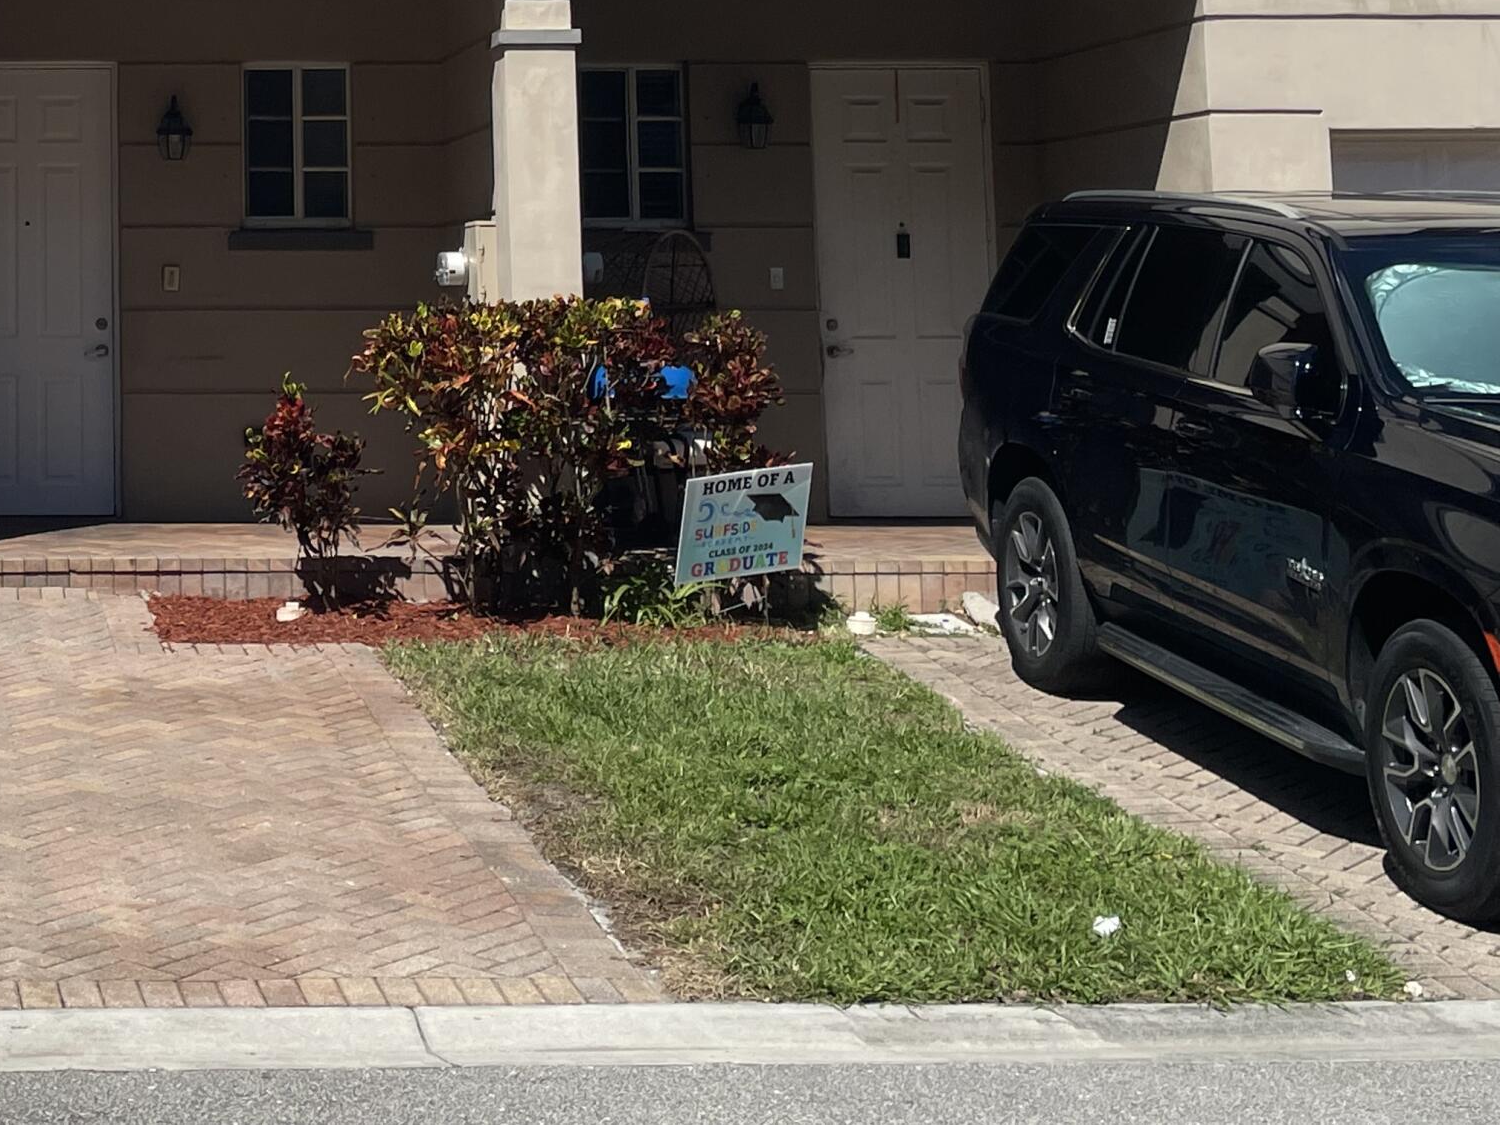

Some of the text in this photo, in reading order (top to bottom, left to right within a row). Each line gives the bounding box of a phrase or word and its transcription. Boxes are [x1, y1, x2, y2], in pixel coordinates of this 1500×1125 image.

[703, 471, 795, 496] HOME OF A
[708, 547, 736, 558] CLASS
[738, 545, 751, 554] OF
